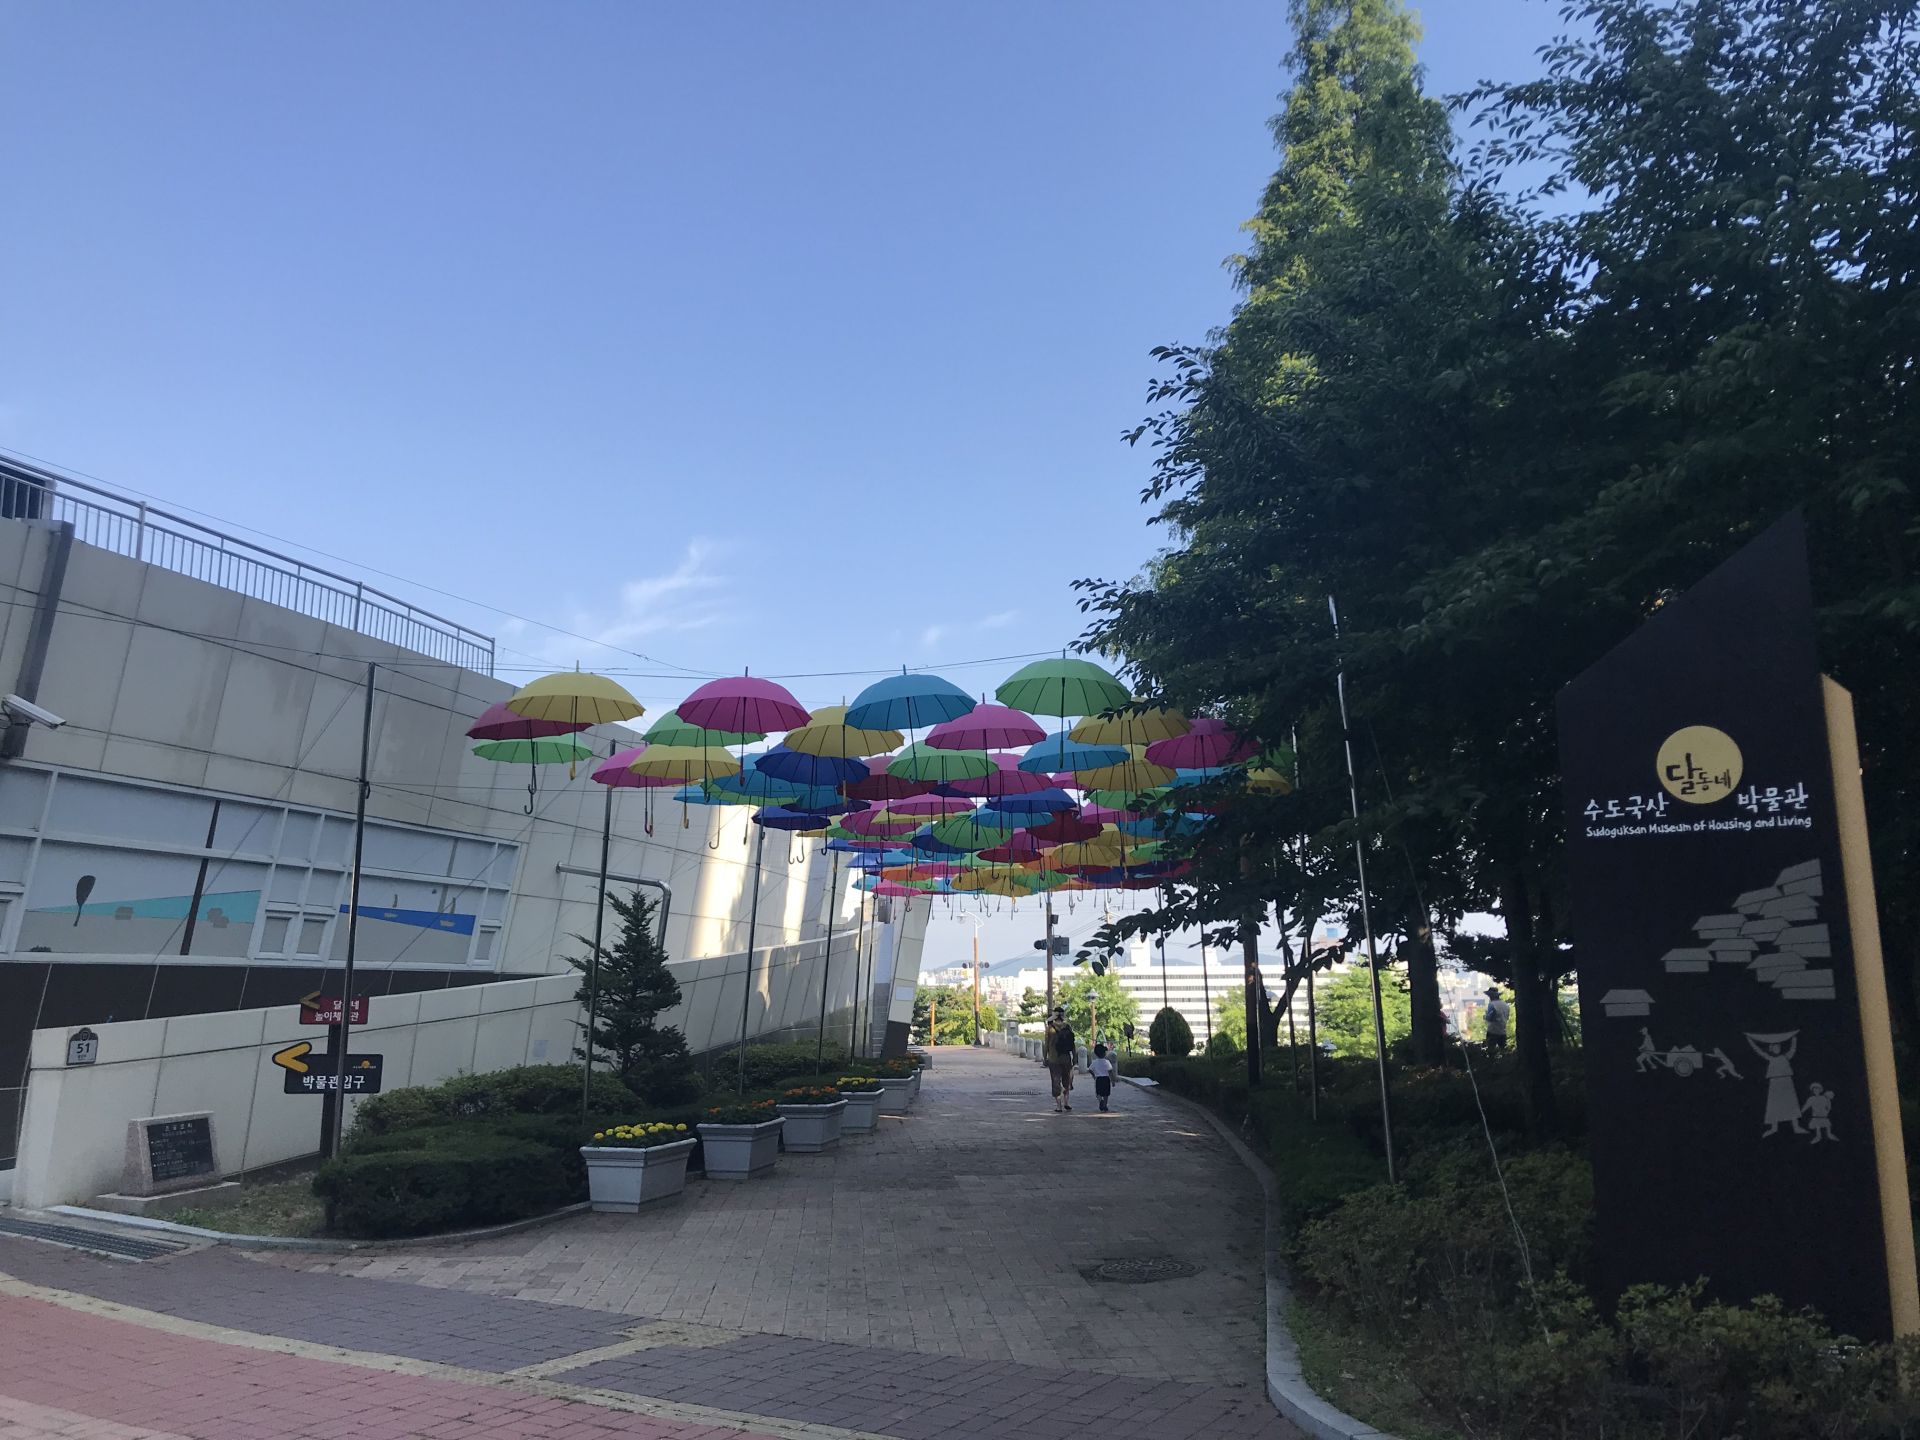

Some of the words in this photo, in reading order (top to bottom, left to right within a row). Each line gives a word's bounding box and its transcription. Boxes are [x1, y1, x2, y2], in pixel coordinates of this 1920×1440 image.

[1584, 791, 1670, 821] 수도국산
[1665, 752, 1732, 795] 달동네
[1738, 782, 1809, 813] 박물관
[1586, 825, 1647, 838] Sudoguksan
[1649, 823, 1692, 833] Museum
[1693, 820, 1707, 831] of
[1708, 817, 1752, 831] Housing
[1754, 816, 1775, 828] and
[1777, 815, 1812, 828] Living
[333, 1000, 360, 1010] 달네
[315, 1011, 359, 1022] 놀이체관
[76, 1043, 90, 1054] 51
